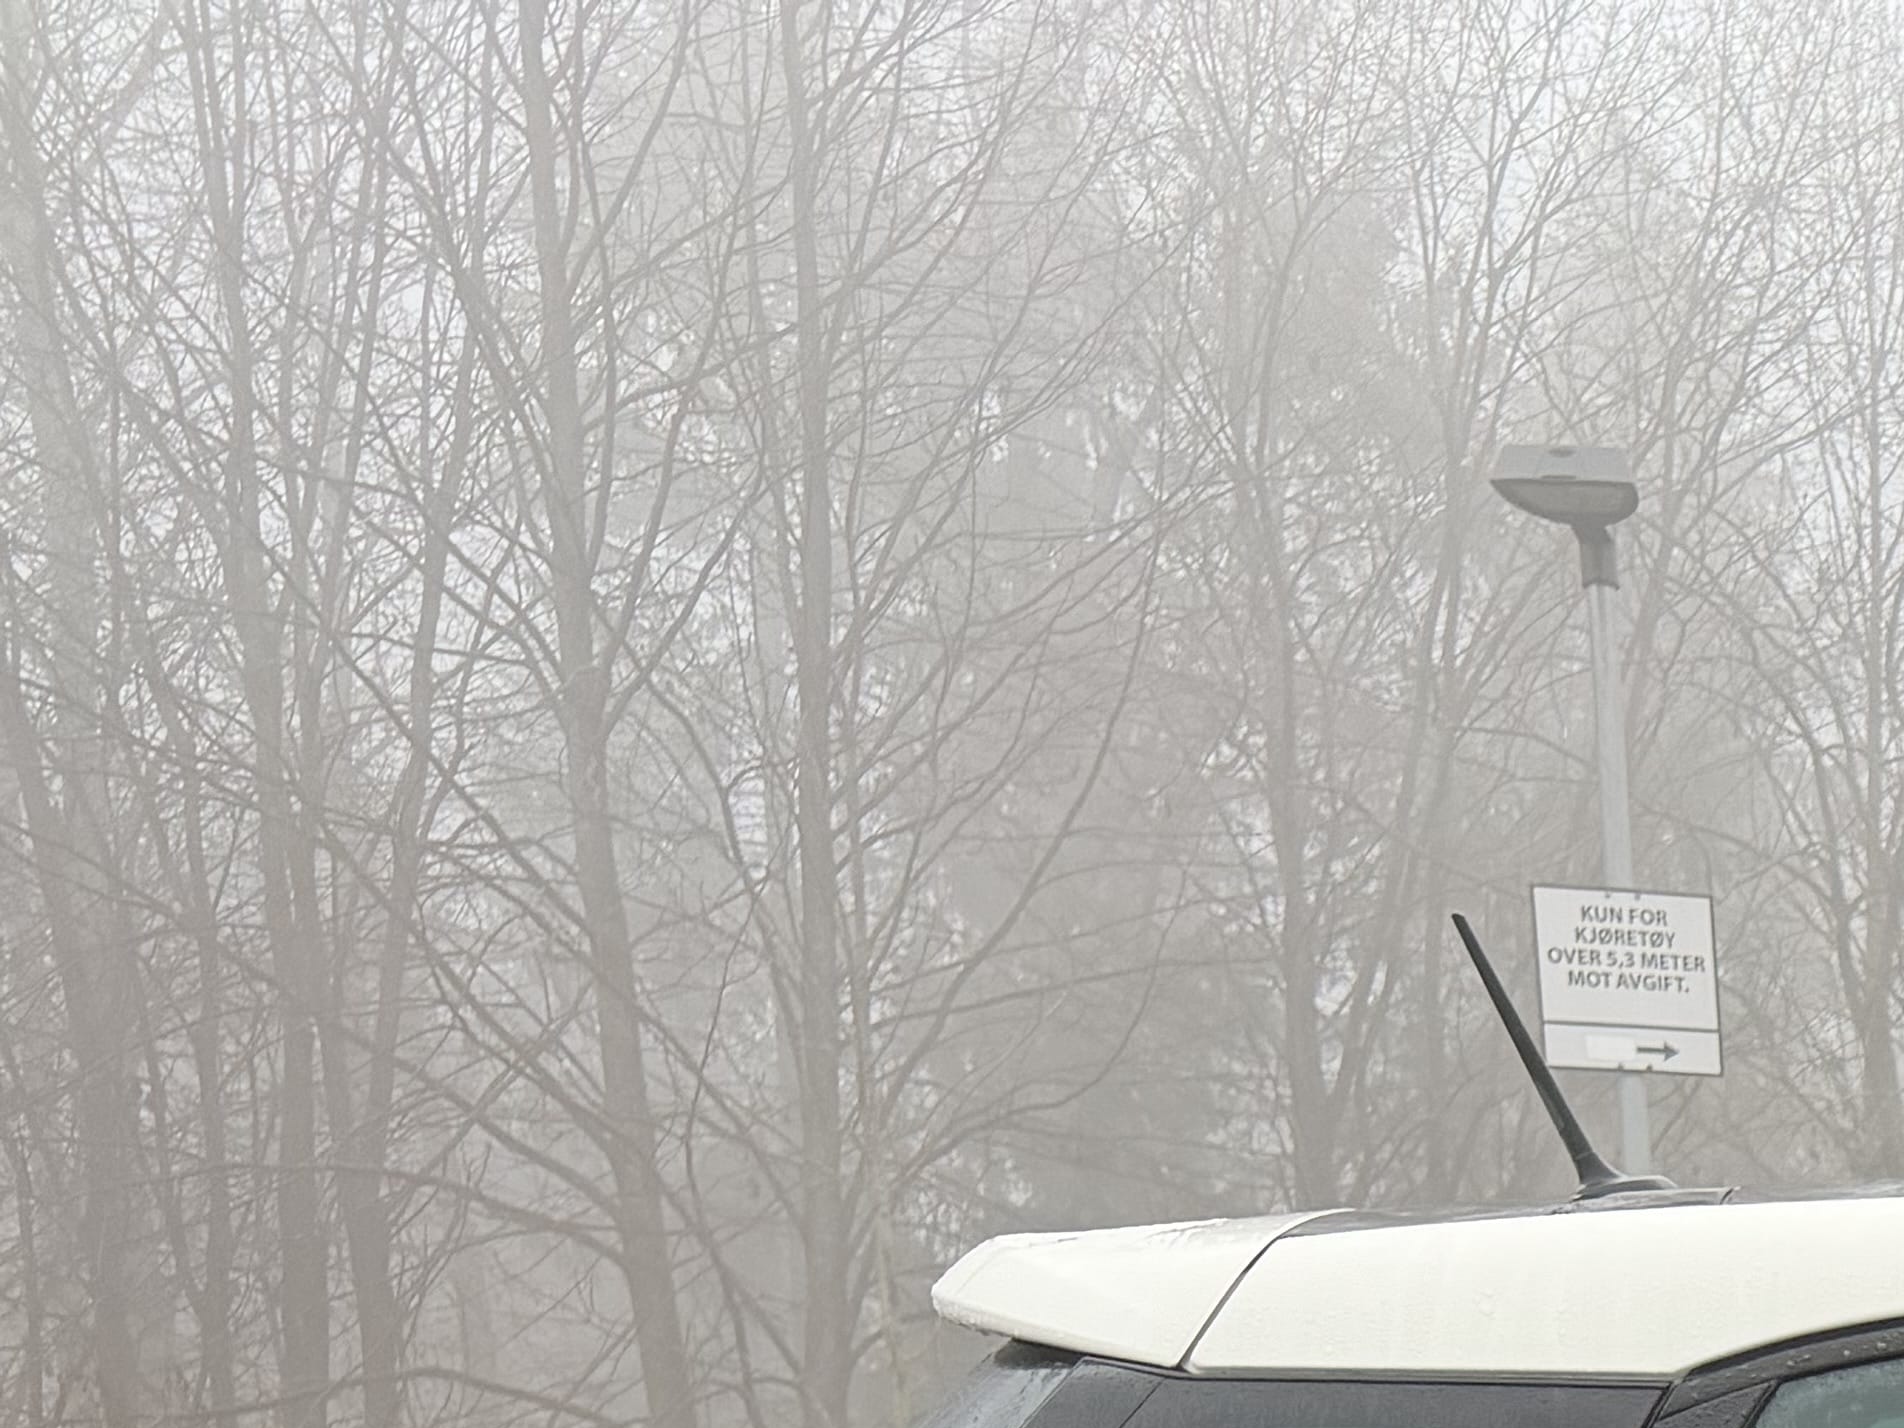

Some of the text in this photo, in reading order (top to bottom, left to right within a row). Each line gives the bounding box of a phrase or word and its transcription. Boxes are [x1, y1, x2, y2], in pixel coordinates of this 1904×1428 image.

[1581, 905, 1667, 926] KUN FOR
[1574, 927, 1675, 948] KJØRETØY
[1547, 947, 1706, 973] OVER 5,3 METER
[1568, 970, 1690, 994] MOT AVGIFT.
